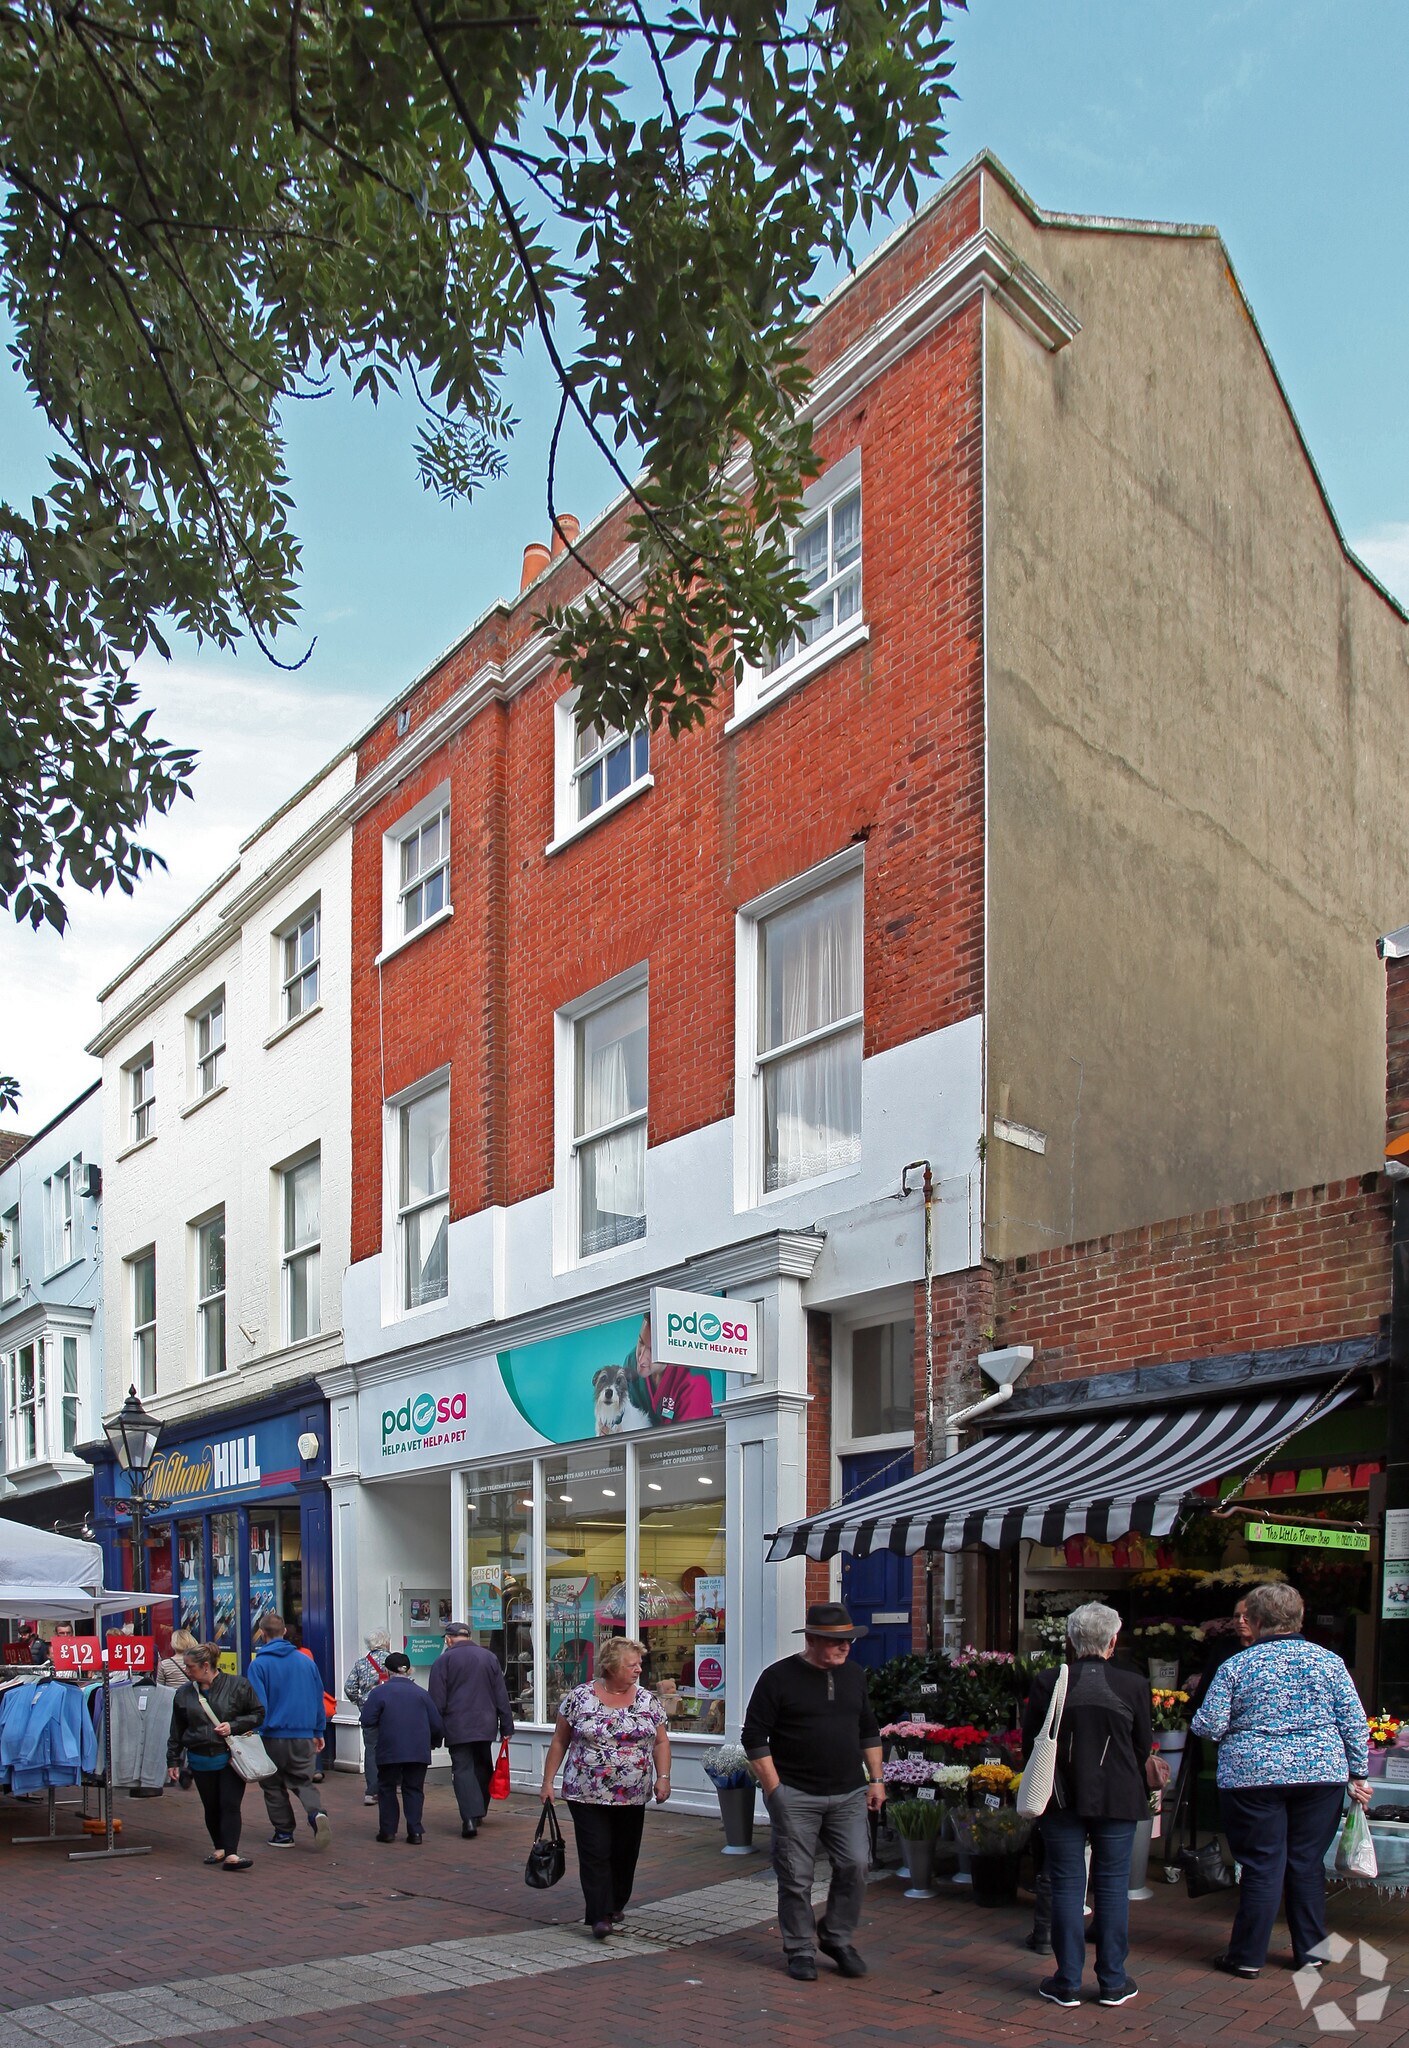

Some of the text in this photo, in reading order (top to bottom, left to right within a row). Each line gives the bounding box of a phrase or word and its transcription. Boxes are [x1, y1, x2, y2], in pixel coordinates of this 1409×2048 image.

[668, 1311, 748, 1342] pdsa
[668, 1338, 687, 1348] HELP
[687, 1340, 694, 1349] A
[693, 1341, 709, 1351] VET
[709, 1344, 728, 1353] HELP
[734, 1347, 748, 1356] PET
[382, 1392, 467, 1446] pdsa
[382, 1430, 466, 1456] HELP A VET HELP A PET
[649, 1444, 719, 1460] YOUR DONATIONS FUND OUR
[143, 1434, 261, 1501] William HILL
[672, 1454, 704, 1464] OPERATIONS
[575, 1471, 585, 1479] AND
[1265, 1526, 1279, 1539] The
[1279, 1527, 1298, 1542] Little
[1299, 1529, 1317, 1544] Flower
[1318, 1530, 1330, 1545] Shop
[485, 1567, 500, 1580] £10
[60, 1643, 94, 1665] £12
[114, 1644, 146, 1665] £12
